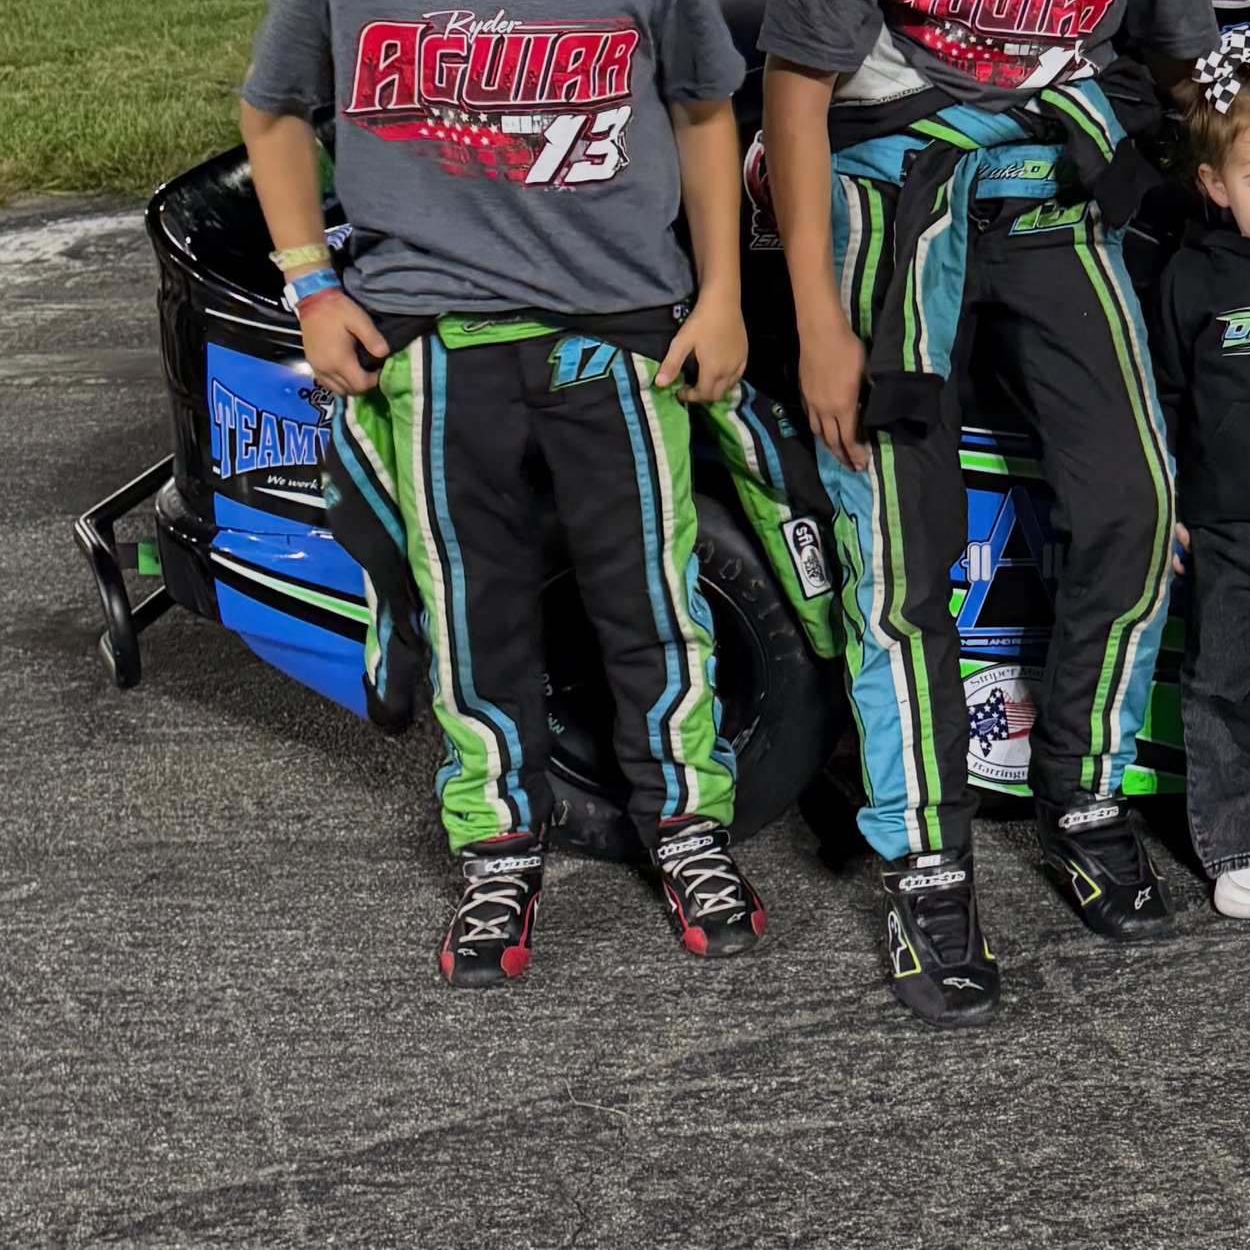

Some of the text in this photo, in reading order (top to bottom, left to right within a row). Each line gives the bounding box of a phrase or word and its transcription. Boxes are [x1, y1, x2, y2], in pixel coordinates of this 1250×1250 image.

[423, 7, 523, 44] Ryder
[346, 20, 640, 114] AGUIAR
[524, 105, 634, 186] 13
[267, 474, 319, 490] We work
